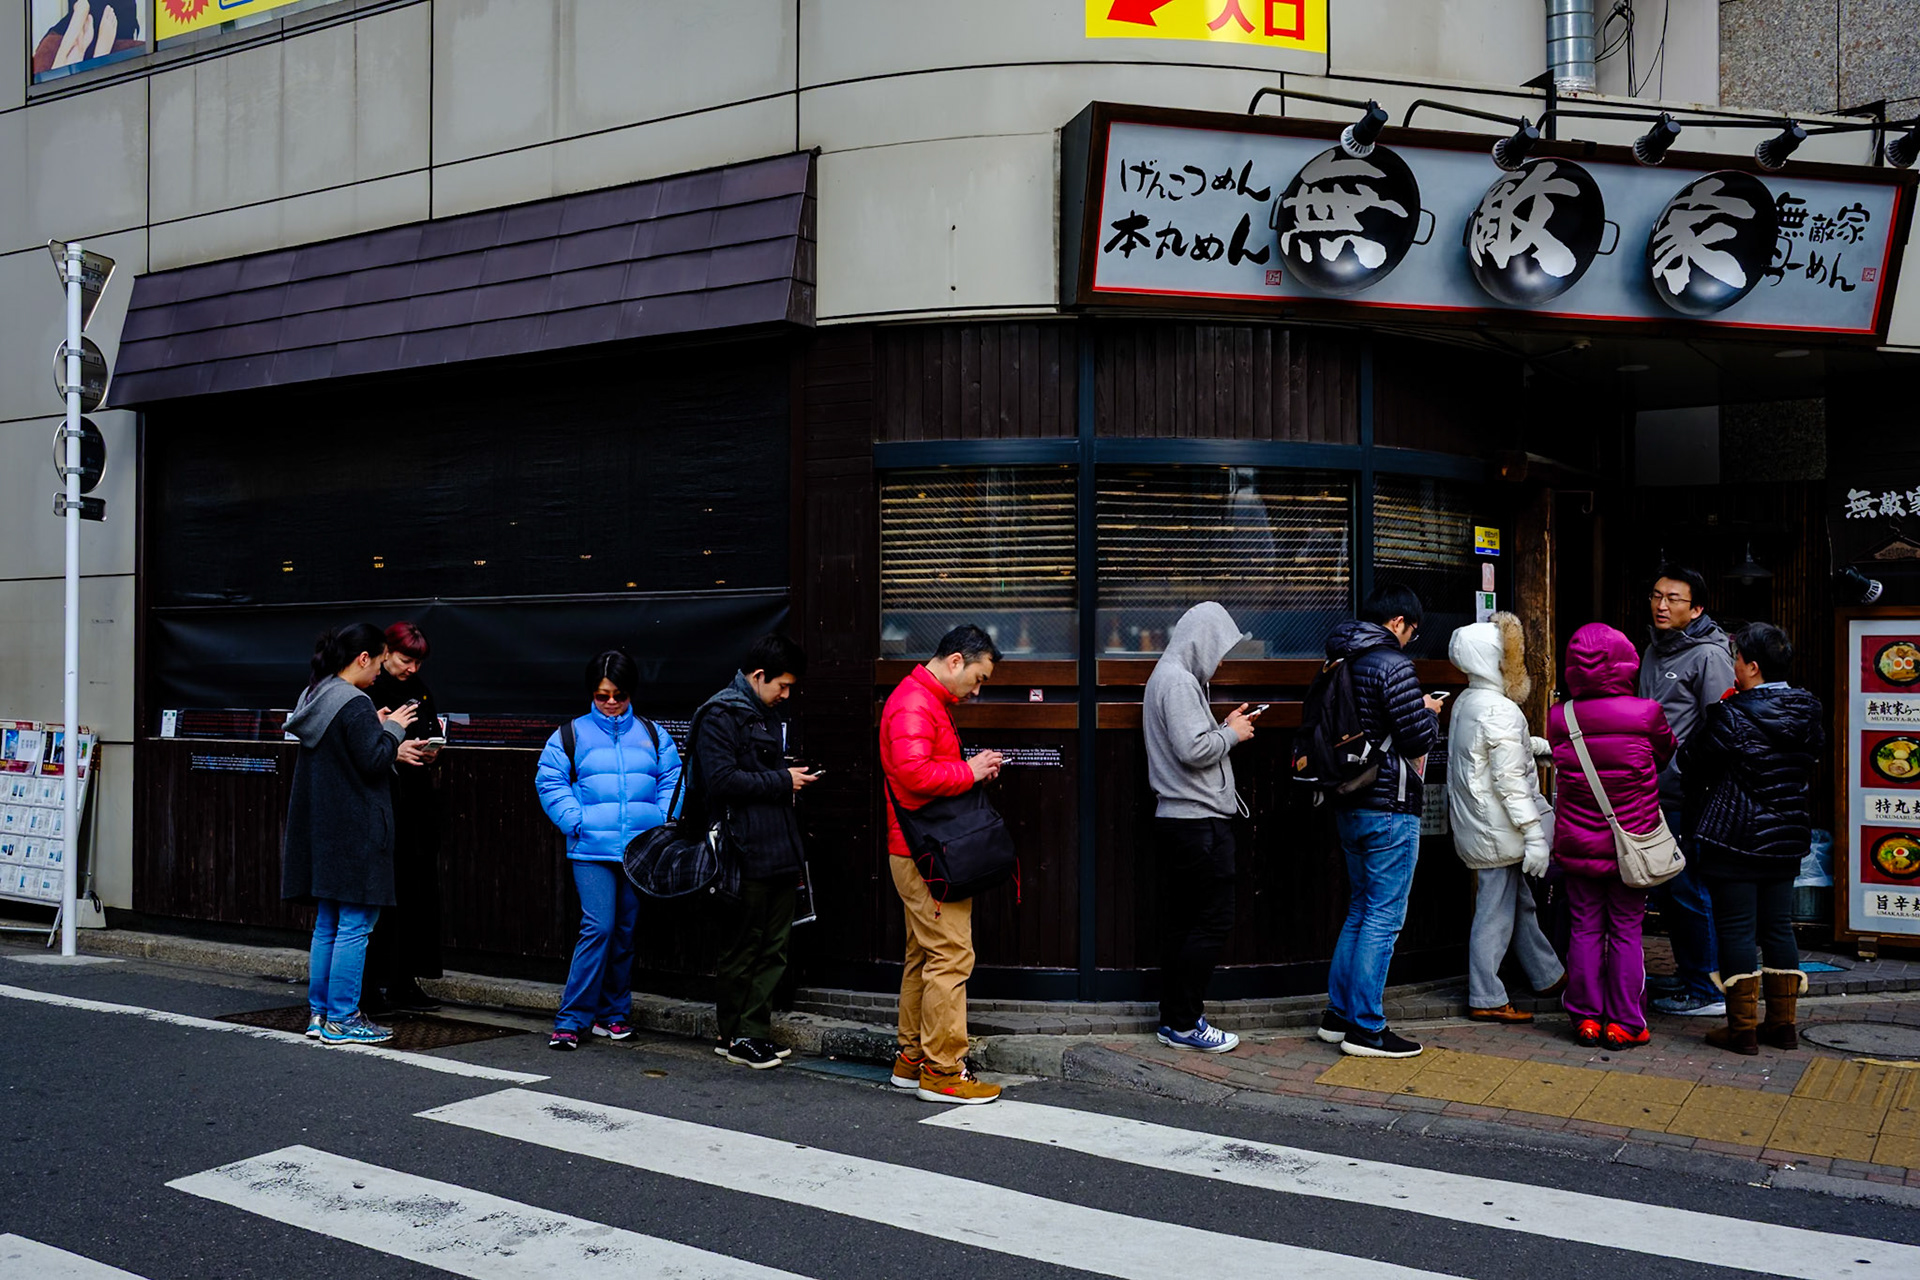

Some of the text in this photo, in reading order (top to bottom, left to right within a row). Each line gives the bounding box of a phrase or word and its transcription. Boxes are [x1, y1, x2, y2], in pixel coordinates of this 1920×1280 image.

[1120, 158, 1270, 202] げんこつめん
[1104, 211, 1269, 266] 本丸めん
[1776, 192, 1870, 245] 無敵家
